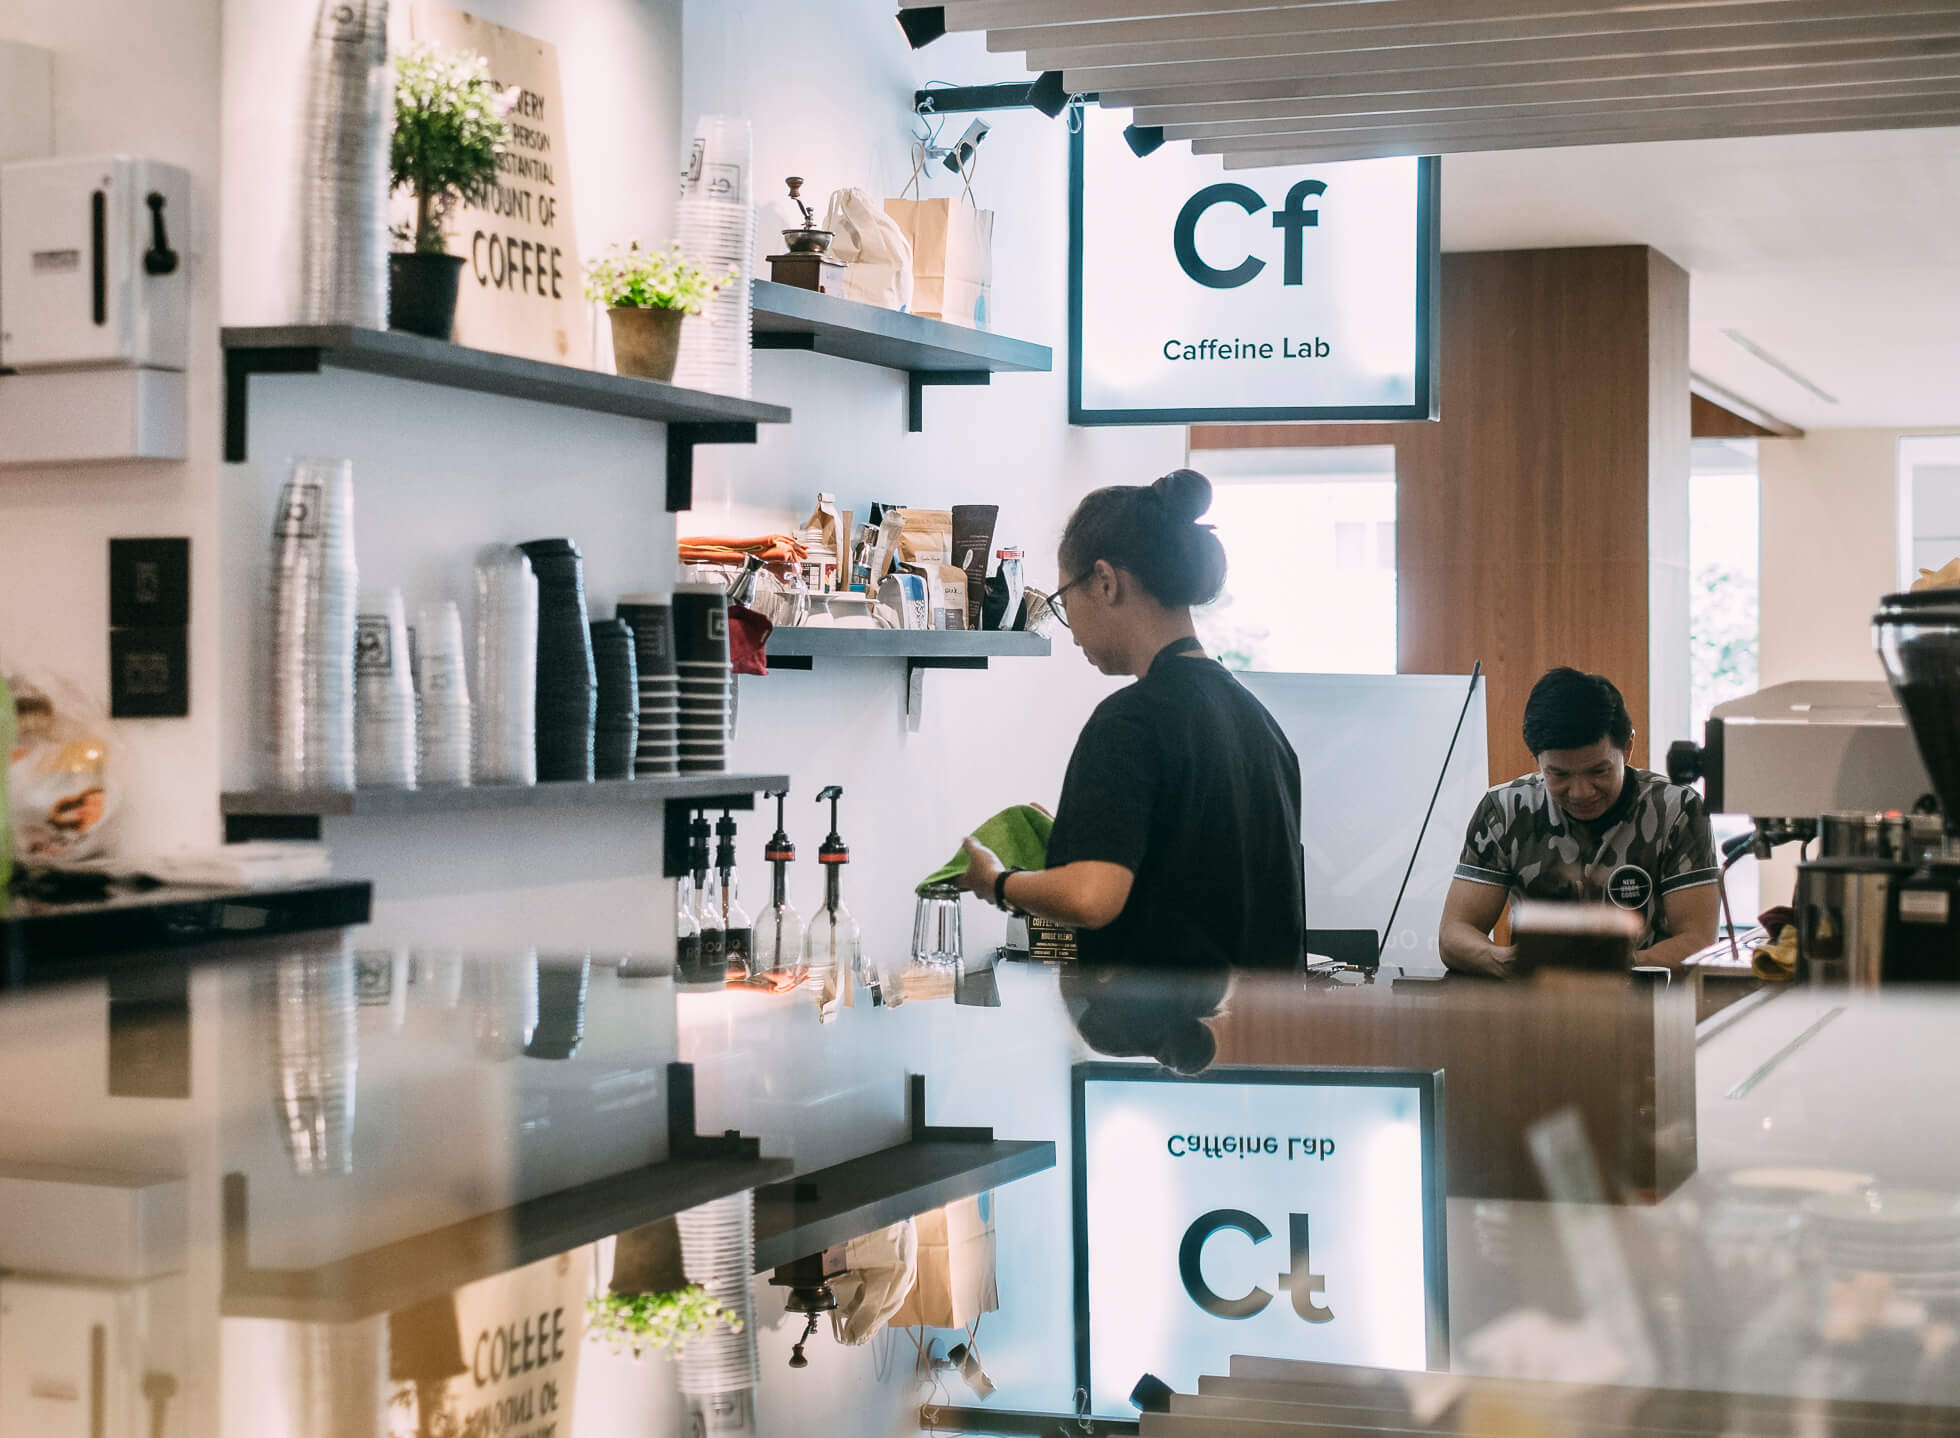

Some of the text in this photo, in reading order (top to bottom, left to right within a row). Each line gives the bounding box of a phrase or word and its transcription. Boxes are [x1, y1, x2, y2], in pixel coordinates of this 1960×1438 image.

[510, 85, 544, 120] VERY
[513, 123, 550, 152] PERSON
[539, 194, 556, 228] OF
[1173, 179, 1328, 289] Cf
[473, 230, 562, 299] COFFEE
[1164, 337, 1330, 361] Caffeine Lab
